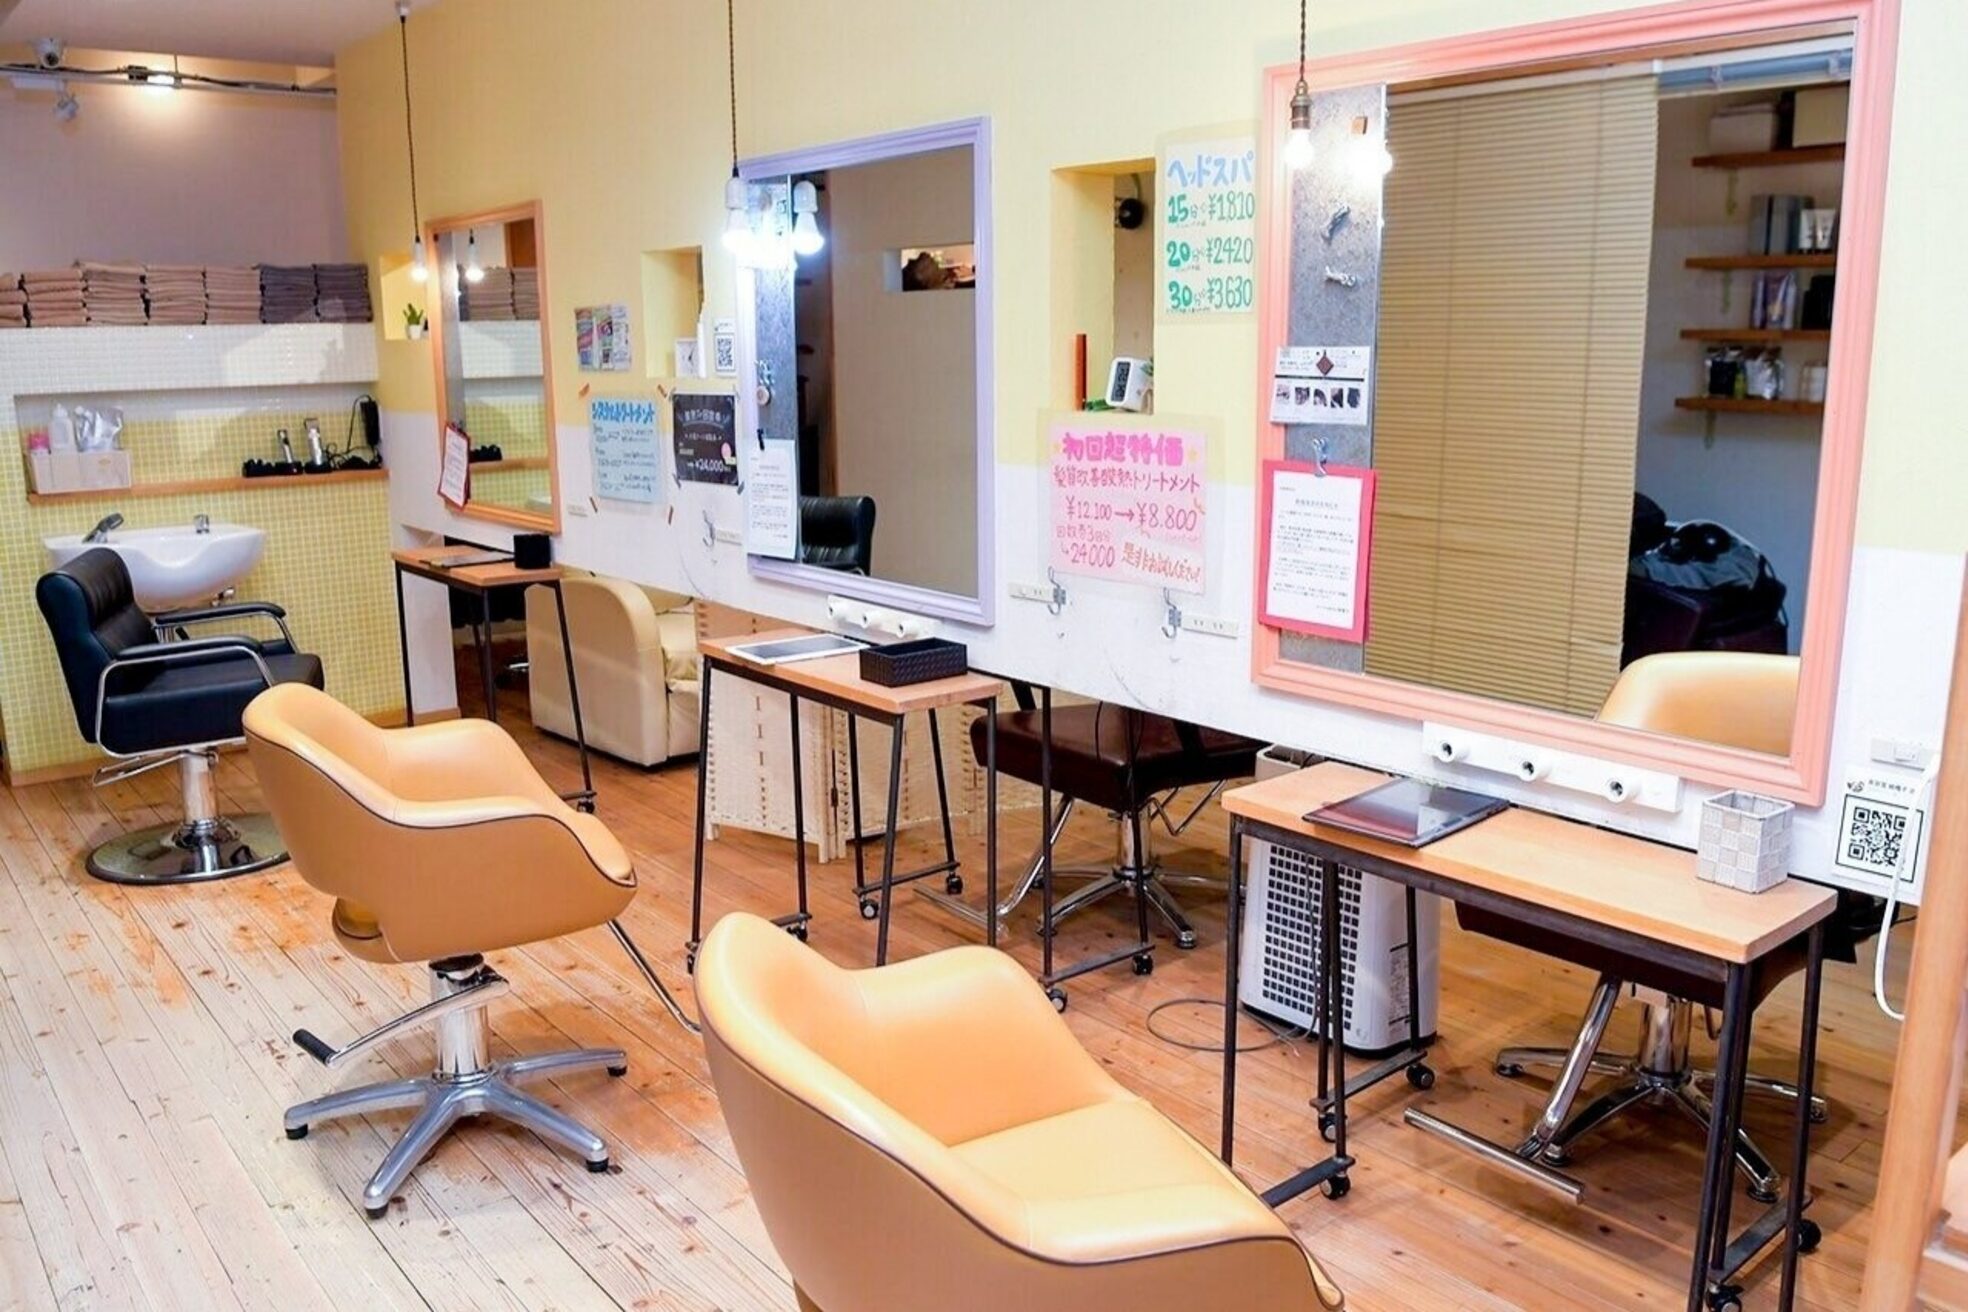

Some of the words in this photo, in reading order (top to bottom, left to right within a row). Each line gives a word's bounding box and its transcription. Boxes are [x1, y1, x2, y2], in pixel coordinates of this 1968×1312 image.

[1167, 150, 1254, 188] ヘッドスパ
[1062, 431, 1184, 467] 初回超特価
[1054, 464, 1200, 494] 髪質改善酸熱トリートメント
